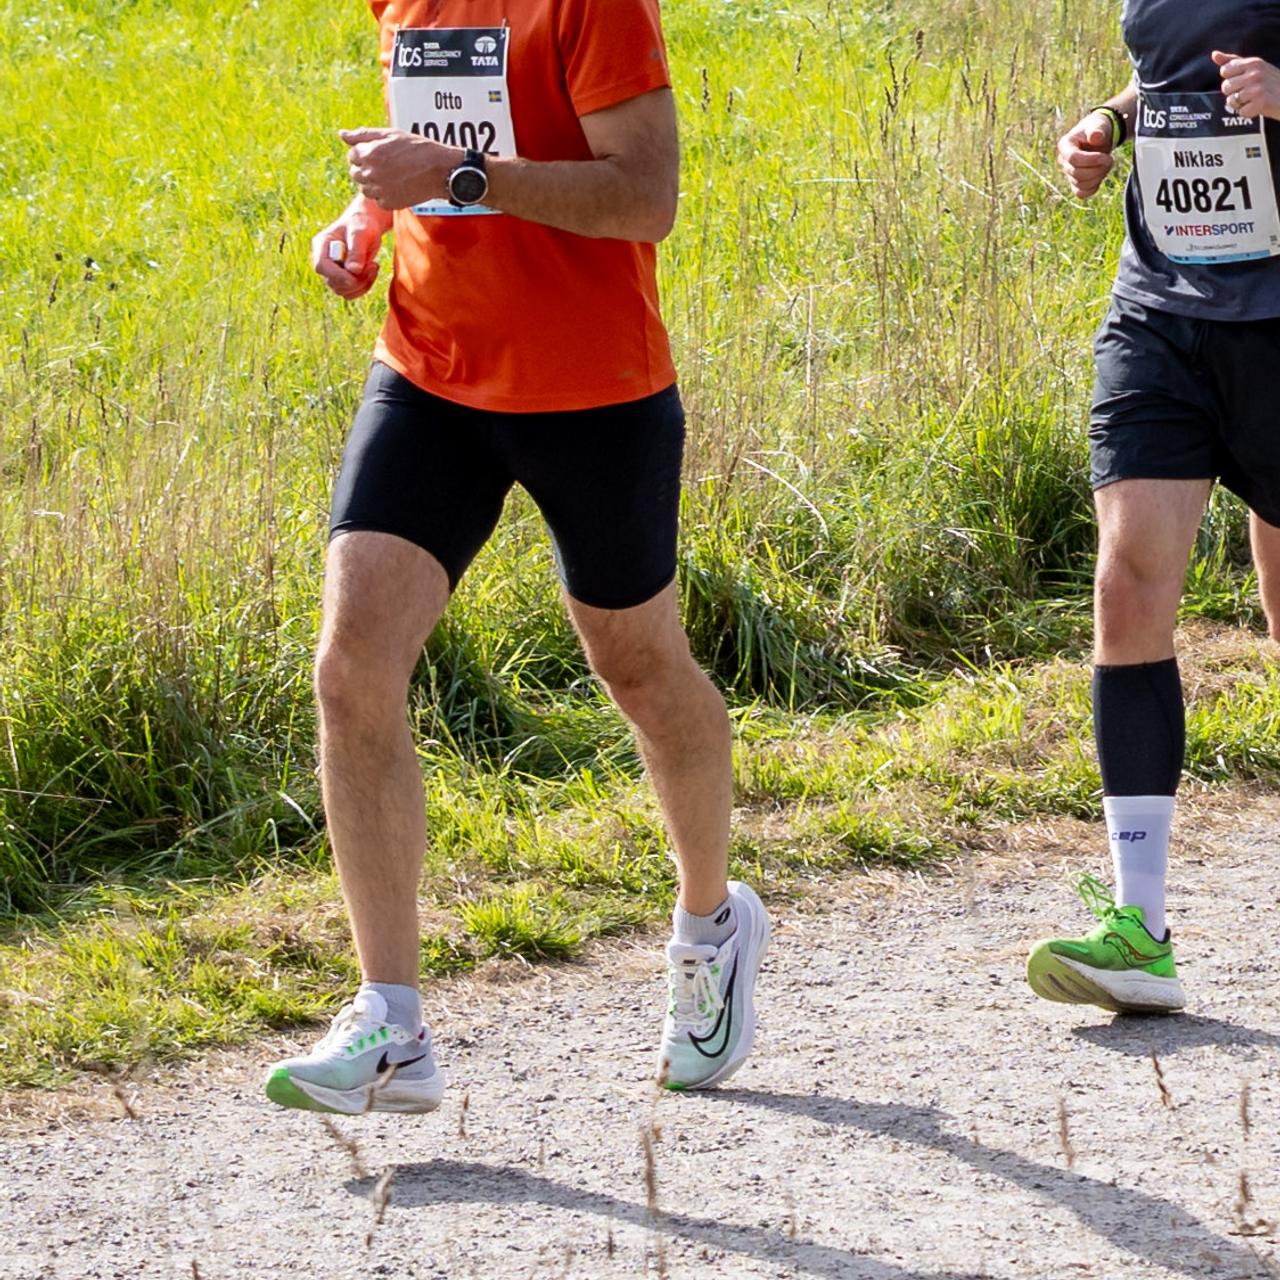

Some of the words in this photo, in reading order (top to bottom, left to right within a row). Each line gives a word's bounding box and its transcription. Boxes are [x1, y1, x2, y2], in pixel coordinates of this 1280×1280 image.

[398, 43, 422, 67] tcs
[470, 56, 499, 66] TATA
[434, 91, 462, 110] Otto
[1143, 105, 1167, 128] tcs
[1221, 116, 1253, 127] TATA
[1173, 151, 1224, 168] Niklas
[1156, 176, 1253, 213] 40821
[1175, 222, 1255, 236] INTERSPORT
